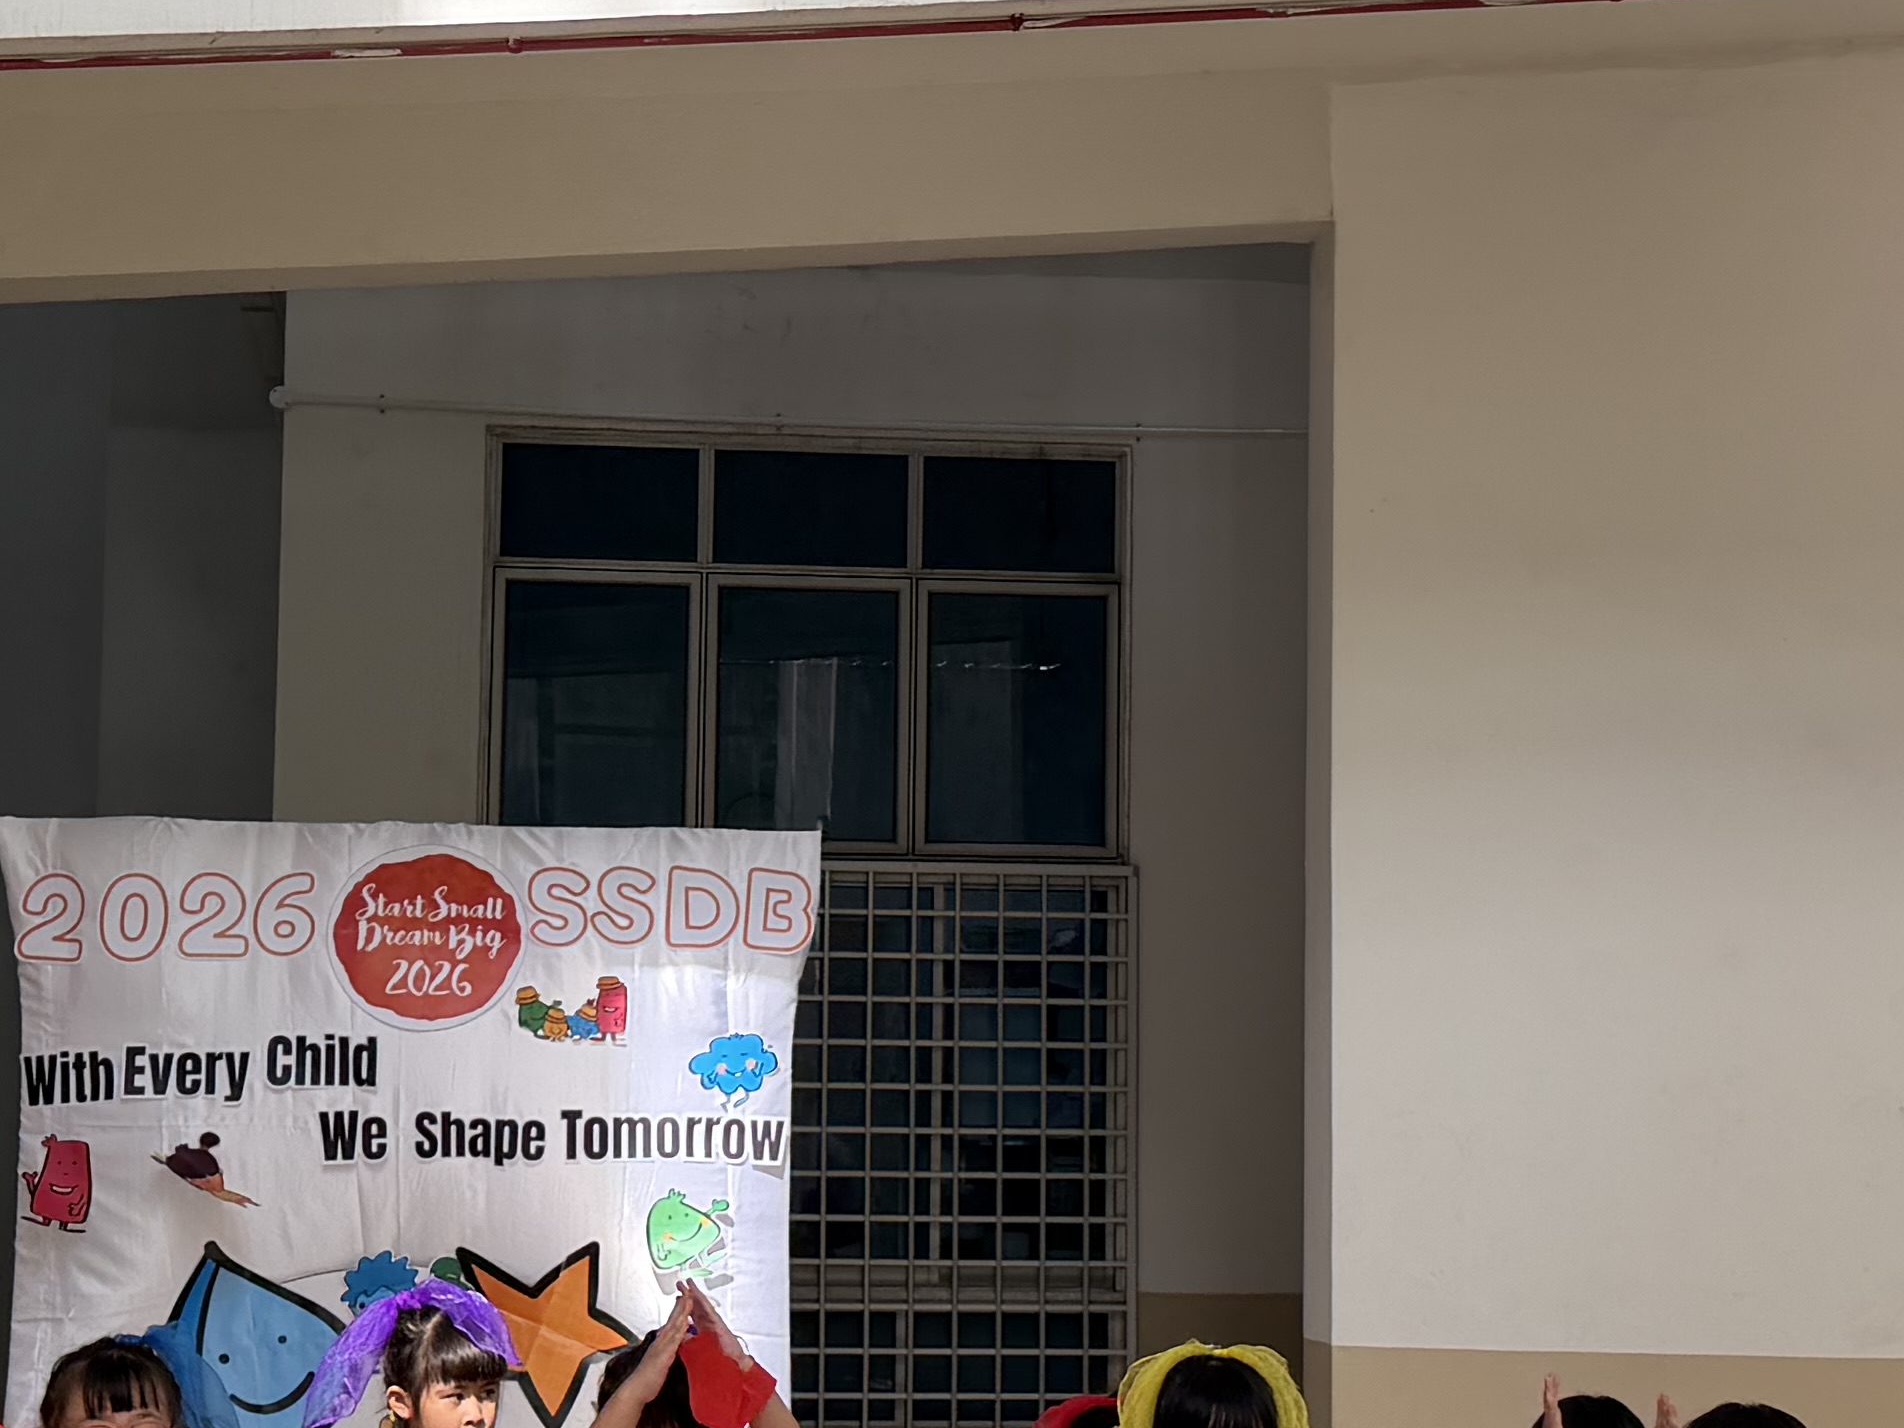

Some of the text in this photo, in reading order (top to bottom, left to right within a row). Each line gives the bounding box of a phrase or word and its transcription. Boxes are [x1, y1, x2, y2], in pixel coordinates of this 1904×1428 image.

[17, 865, 812, 962] 2026 SSDB
[355, 883, 506, 922] Start Small
[356, 919, 507, 960] Dream Big
[385, 959, 473, 997] 2026
[23, 1034, 378, 1107] With Every Child
[319, 1108, 786, 1166] We Shape Tomorrow
